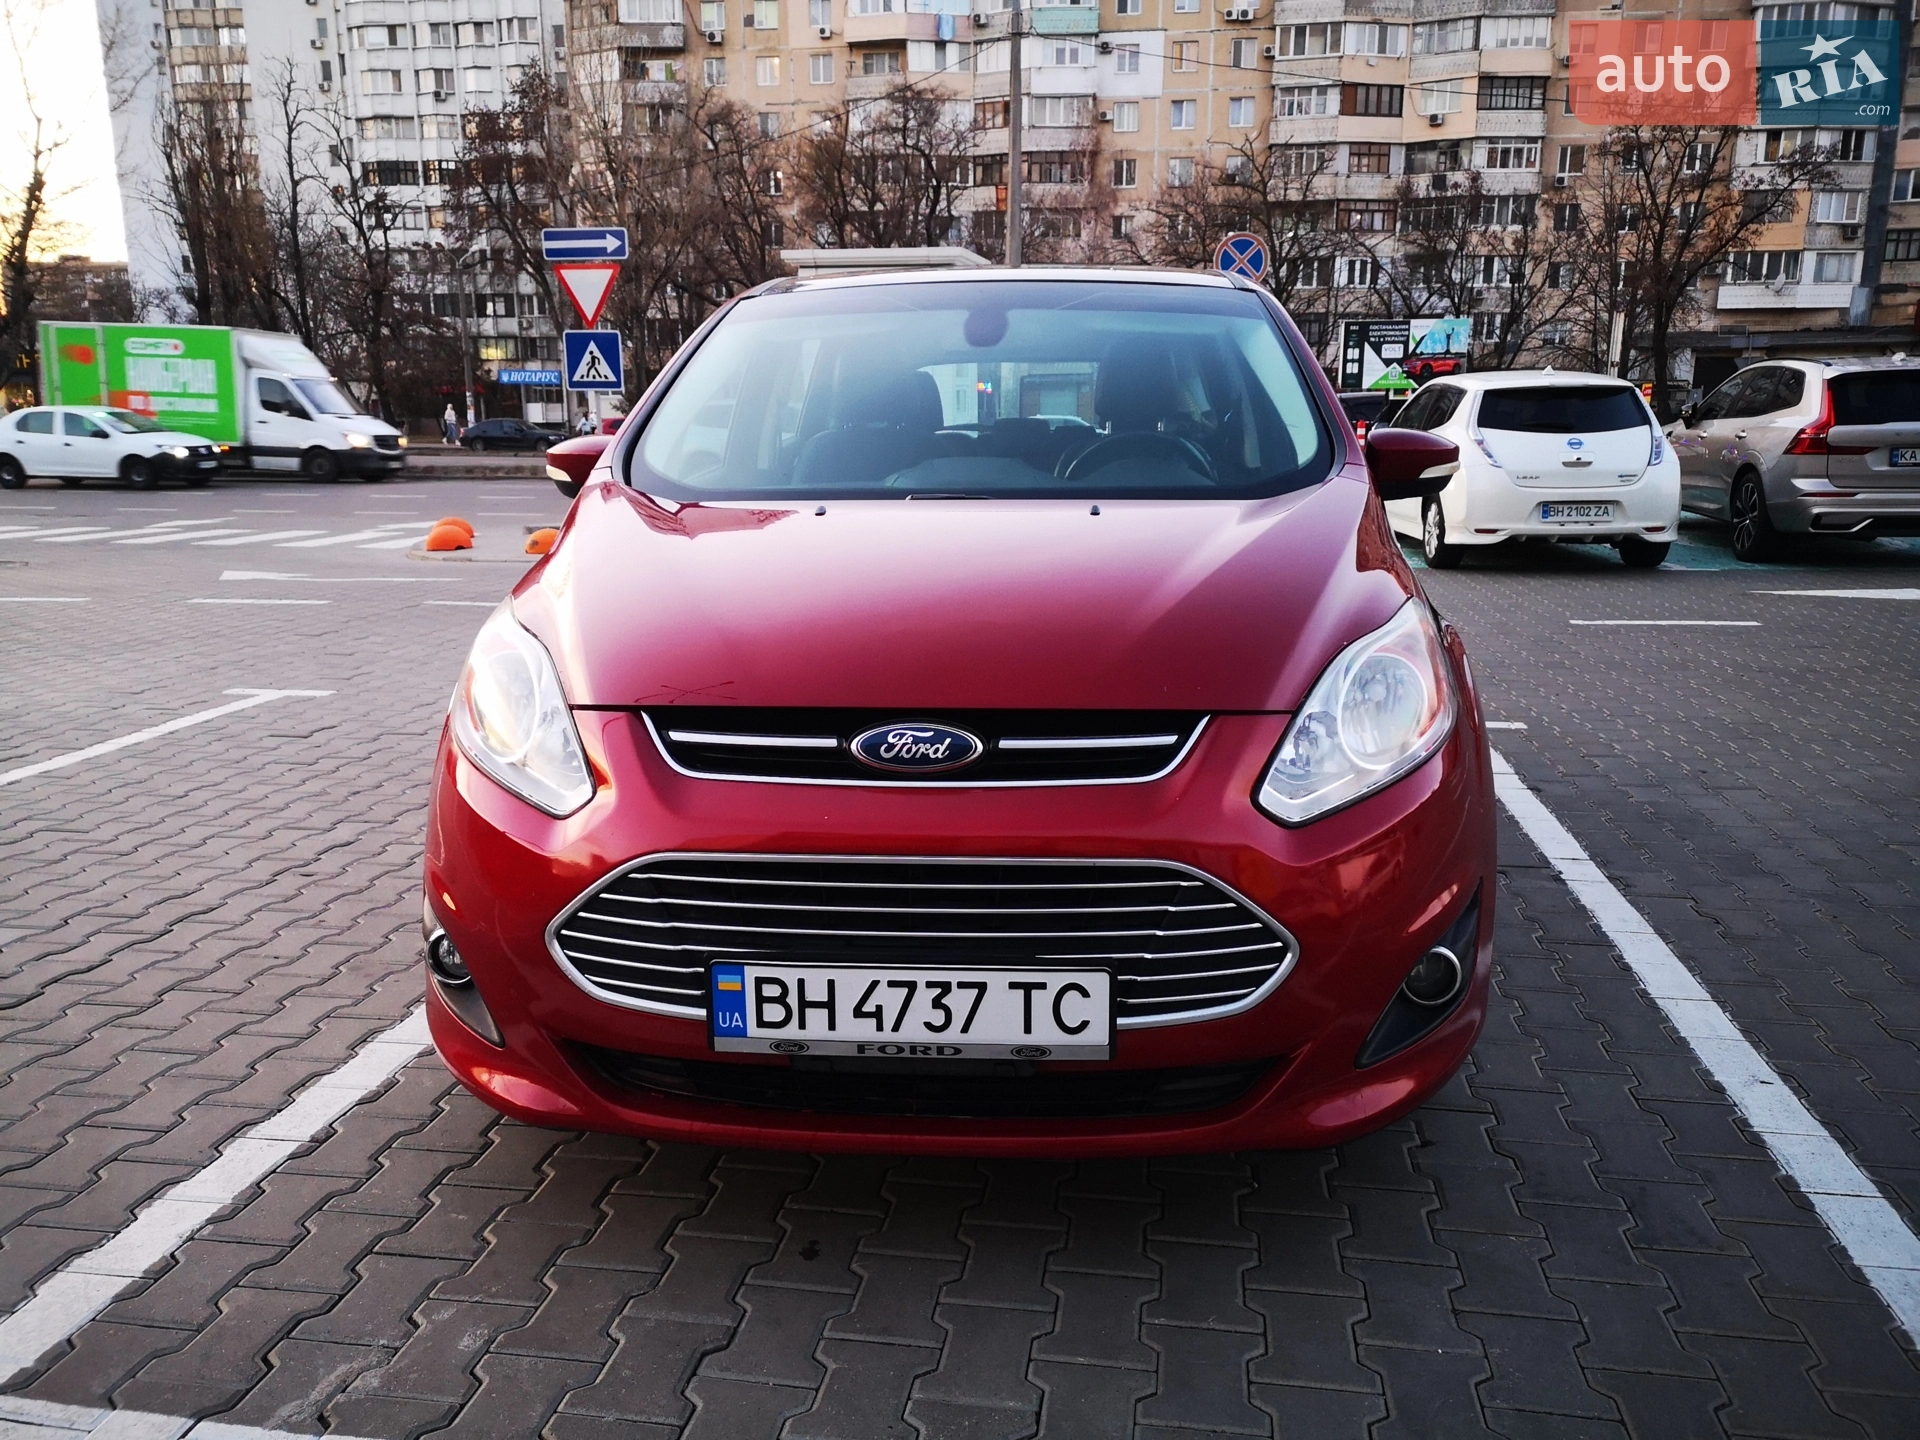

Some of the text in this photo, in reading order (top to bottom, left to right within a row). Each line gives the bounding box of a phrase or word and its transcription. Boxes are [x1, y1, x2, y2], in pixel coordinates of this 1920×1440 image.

[510, 371, 558, 382] НОТАРІУС
[1900, 450, 1918, 461] KA
[1548, 506, 1610, 517] BH 2102 ZA
[879, 729, 952, 759] Ford
[754, 976, 1091, 1036] BH 4737 TC
[718, 1011, 744, 1029] UA
[778, 1042, 800, 1053] Ford
[856, 1043, 963, 1057] FORD
[1020, 1047, 1043, 1058] Ford
